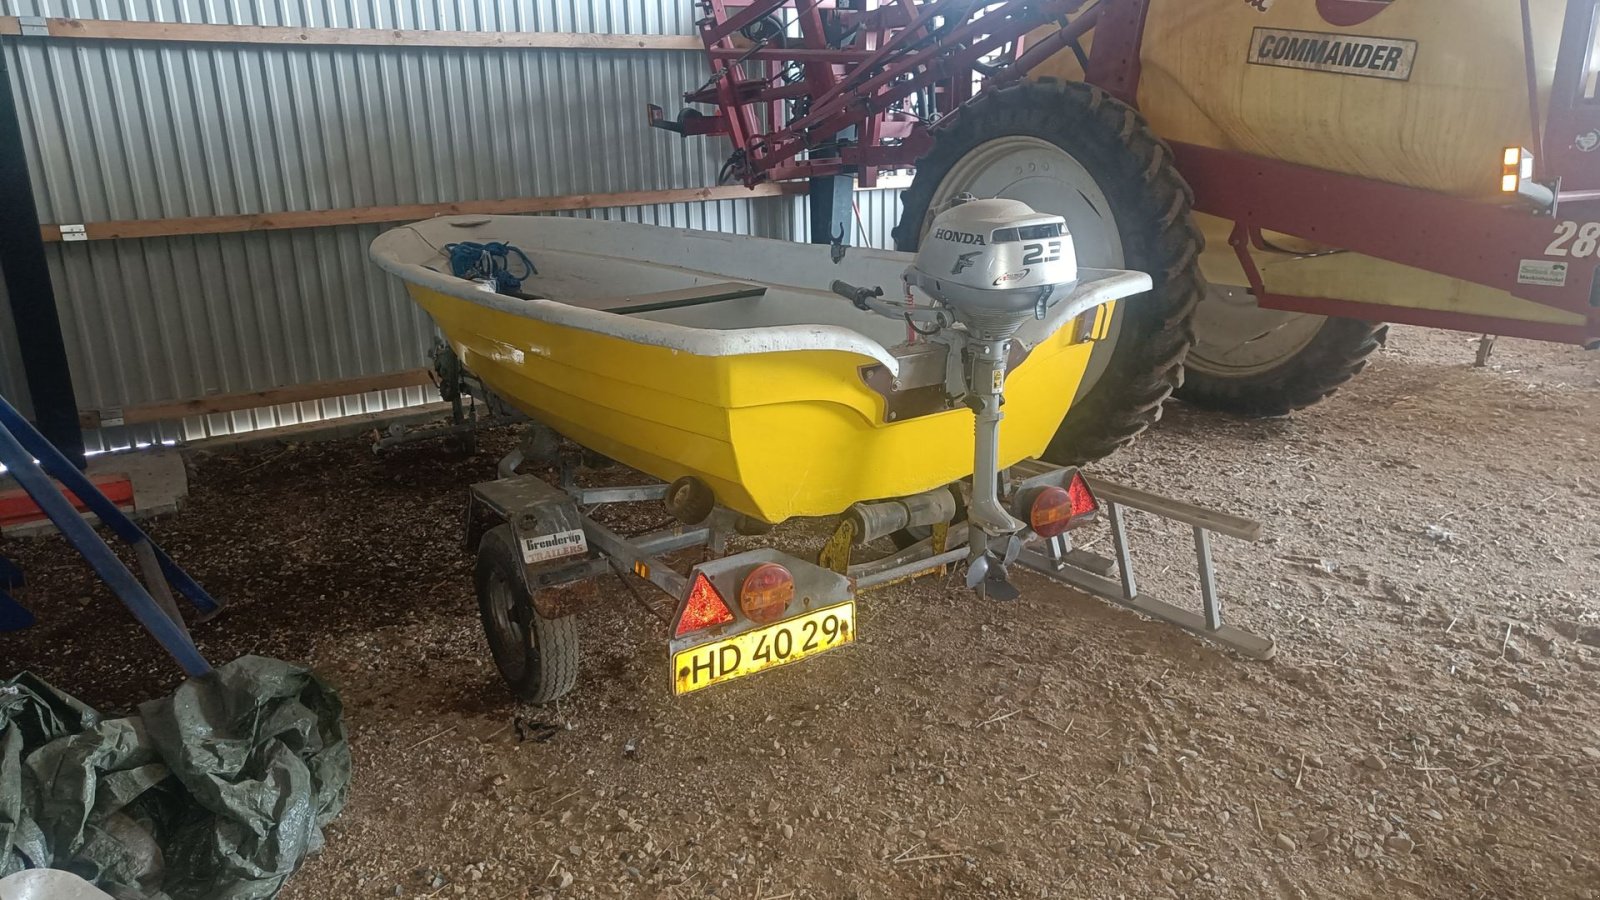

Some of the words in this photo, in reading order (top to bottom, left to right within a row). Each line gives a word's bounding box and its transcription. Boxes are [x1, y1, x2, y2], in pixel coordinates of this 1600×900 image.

[1258, 34, 1403, 72] COMMANDER
[935, 228, 986, 246] HONDA
[1543, 220, 1600, 259] 28
[1023, 241, 1061, 265] 2.3
[526, 534, 581, 551] Brenderup
[528, 544, 584, 561] TRAILERS
[692, 644, 741, 684] HD
[752, 628, 792, 663] 40
[801, 614, 839, 652] 29
